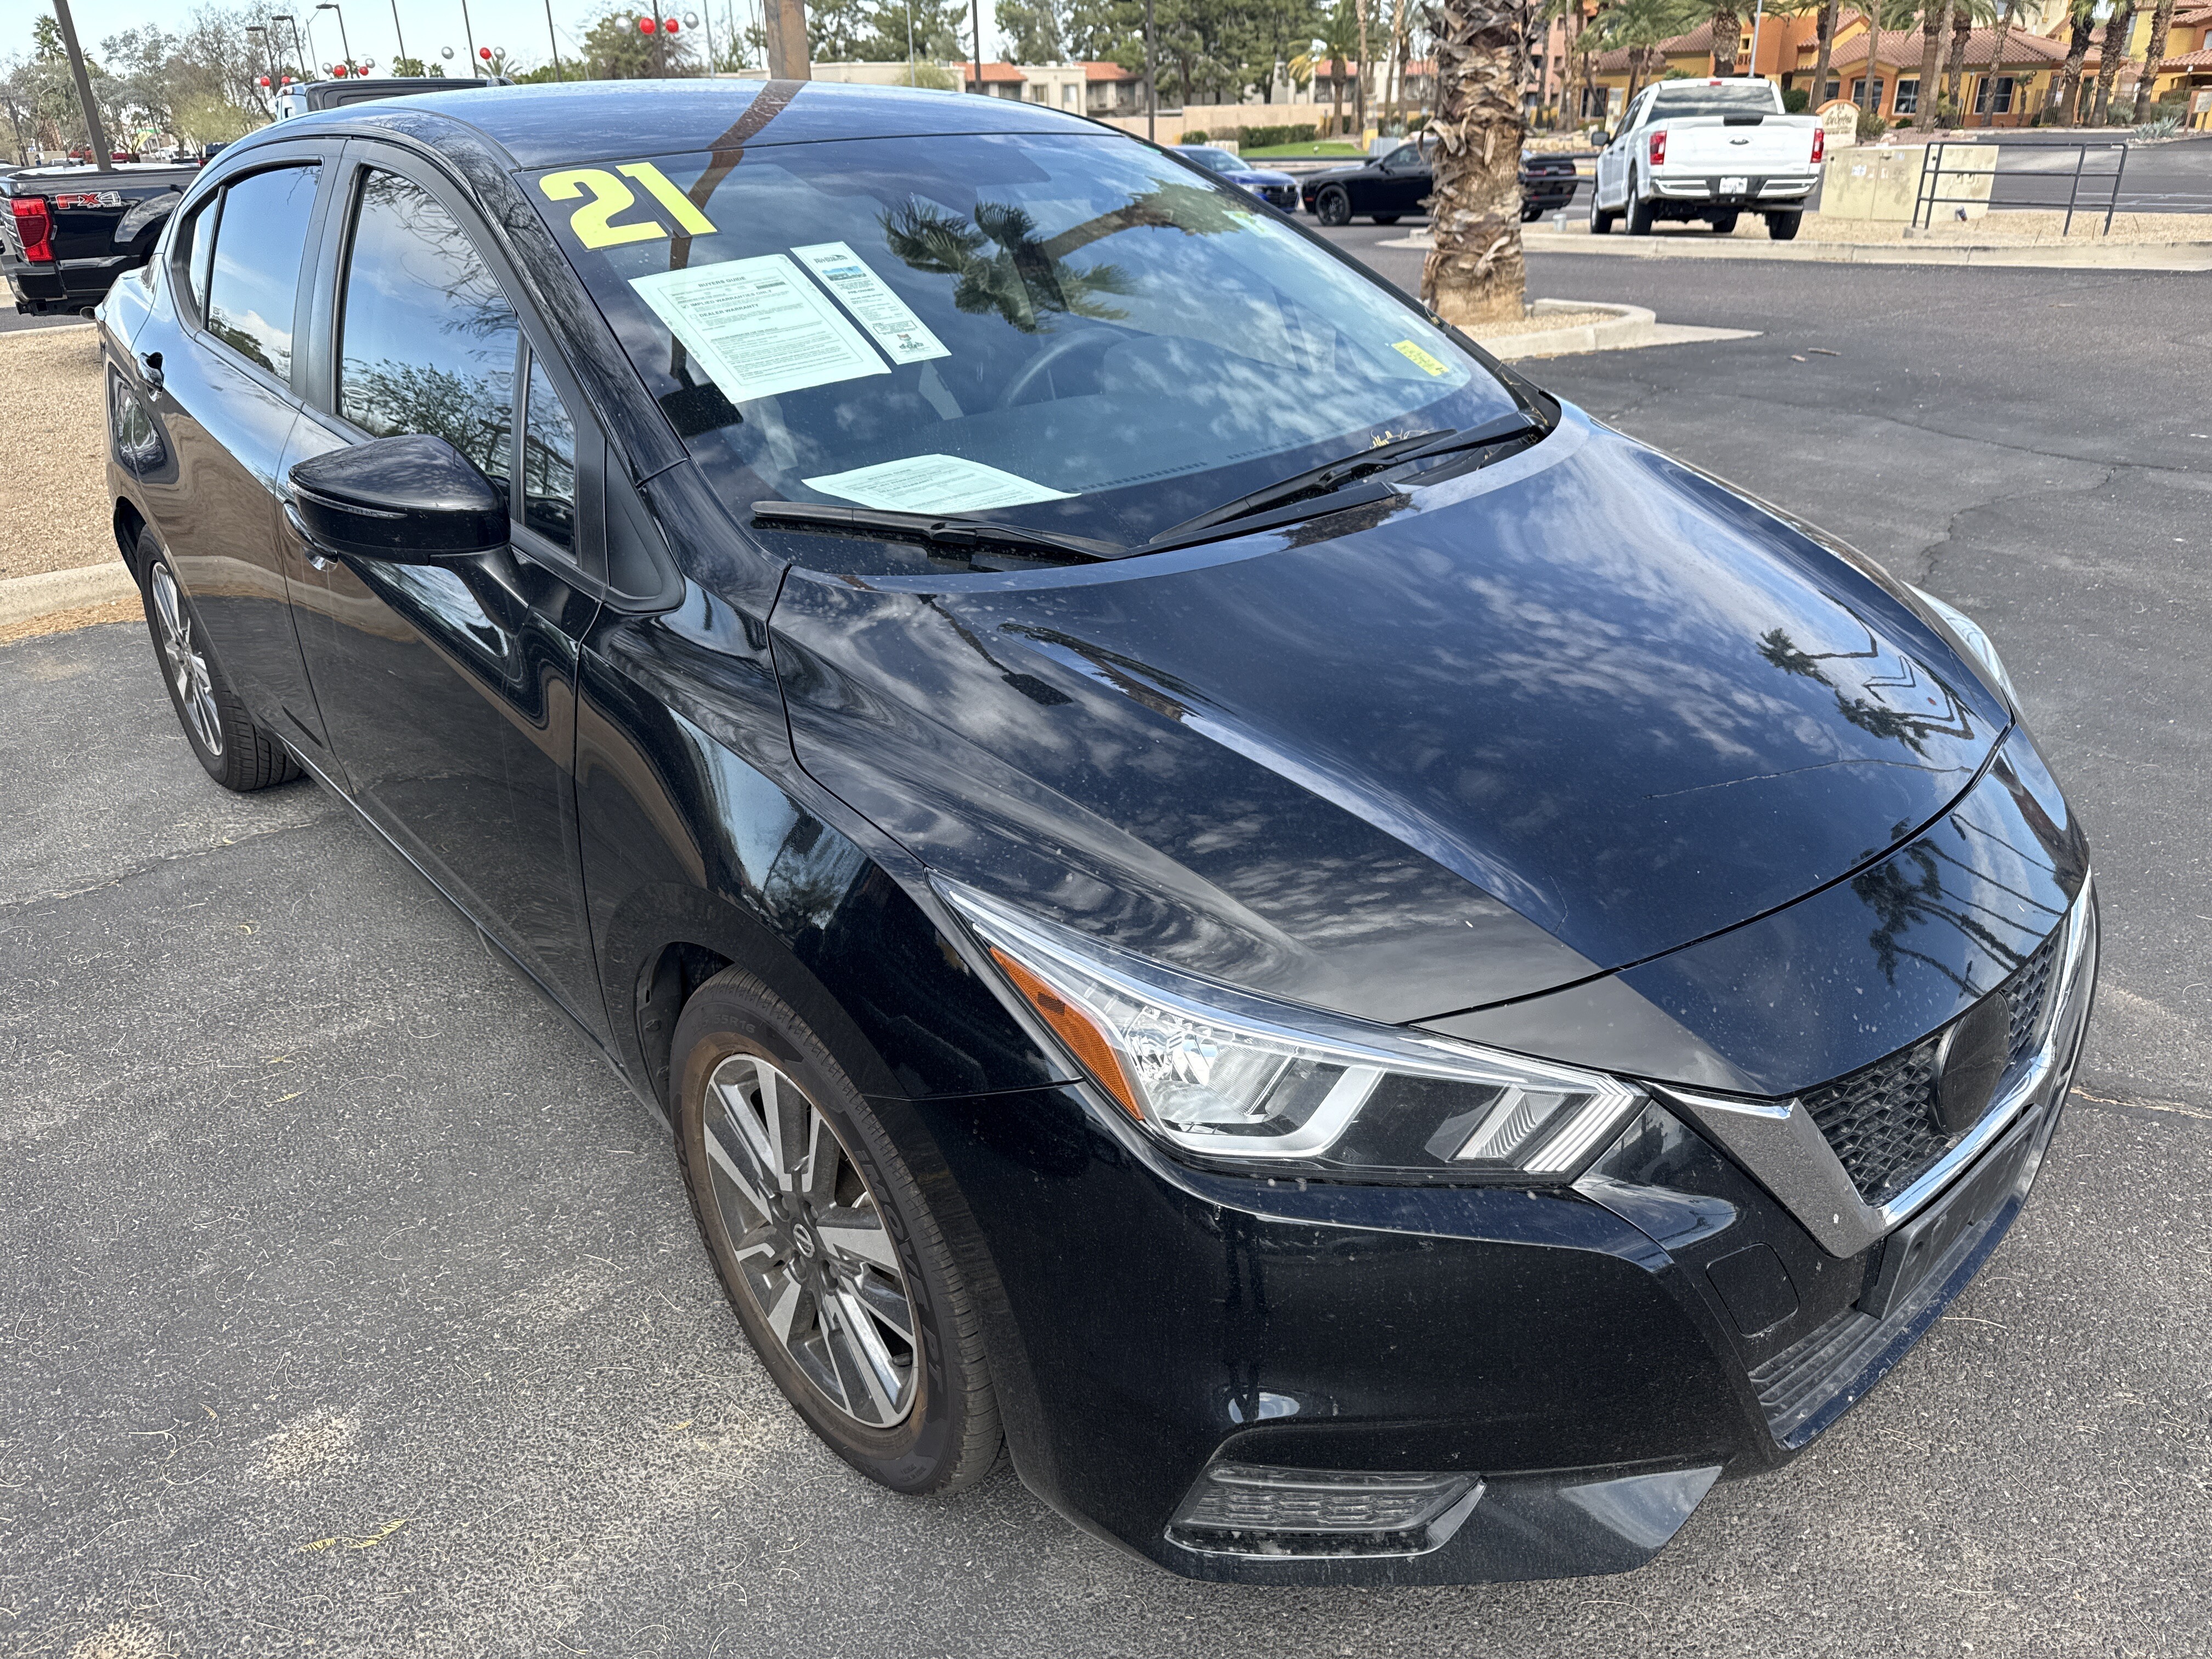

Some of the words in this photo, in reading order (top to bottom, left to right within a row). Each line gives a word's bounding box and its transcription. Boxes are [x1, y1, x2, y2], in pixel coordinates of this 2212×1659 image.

[55, 191, 121, 210] FX4
[539, 162, 717, 249] 21
[715, 292, 755, 303] WARRANTIES
[725, 303, 759, 312] WARRANTY
